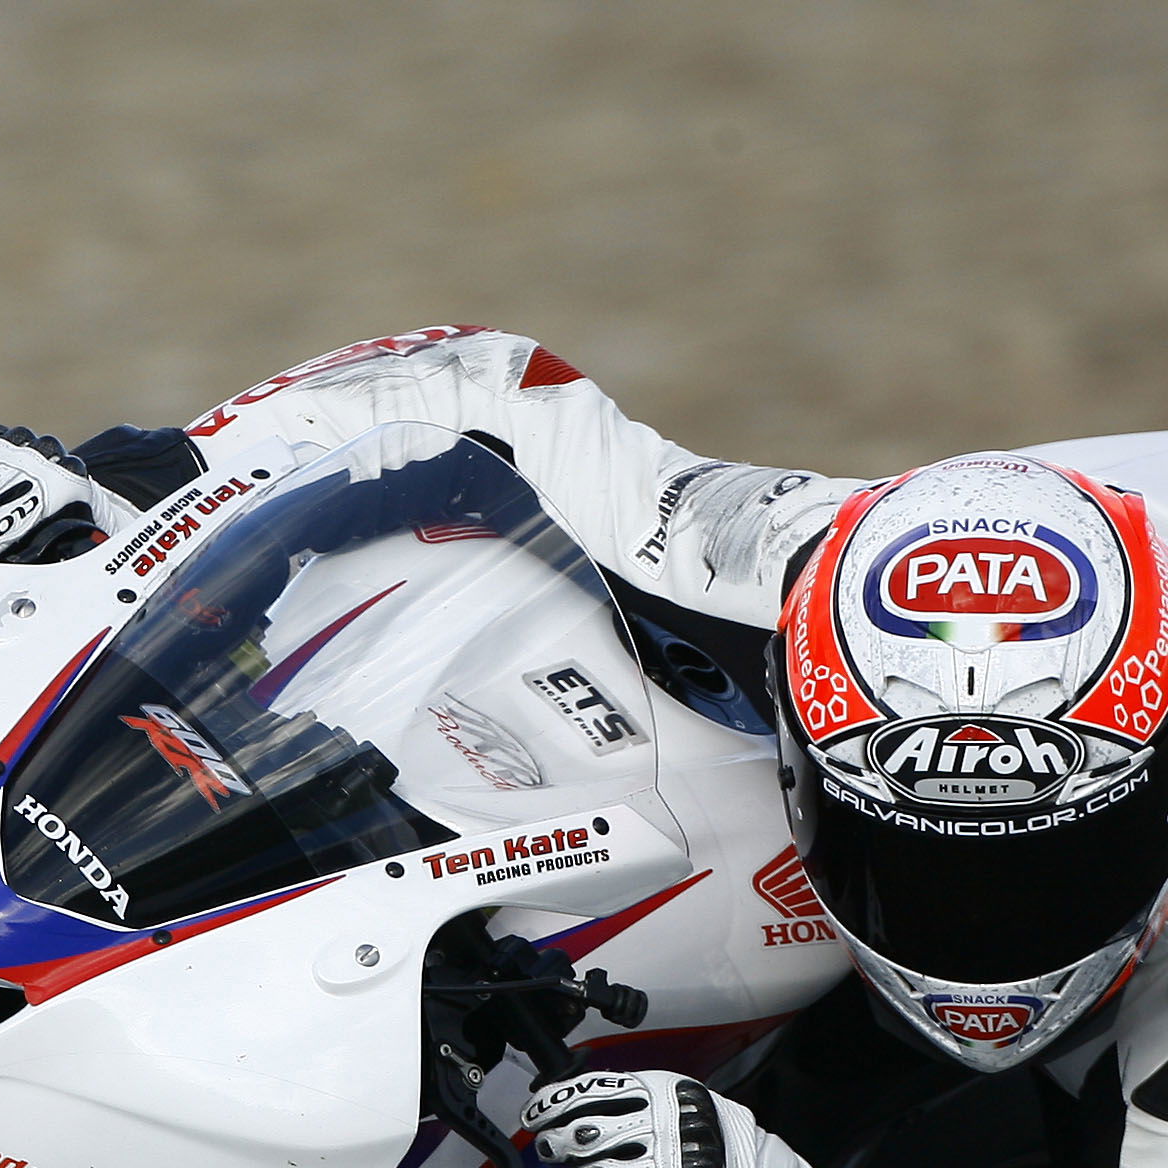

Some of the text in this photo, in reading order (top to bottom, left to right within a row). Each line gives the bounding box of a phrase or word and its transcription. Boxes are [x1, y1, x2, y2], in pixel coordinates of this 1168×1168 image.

[105, 488, 203, 575] RACING PRODUCTS
[132, 477, 255, 577] Ten Kate
[932, 518, 1032, 536] SNACK
[906, 552, 1048, 603] PATA
[533, 679, 603, 747] Racing Fuels
[546, 667, 637, 743] ETS
[883, 725, 1071, 775] Airoh
[822, 768, 1150, 836] GALVANICOLOR.COM
[938, 783, 1010, 794] HELMET
[13, 794, 130, 920] HONDA
[423, 828, 589, 880] Ten Kate
[476, 849, 610, 886] RACING PRODUCTS
[944, 1010, 1019, 1033] PATA
[952, 994, 1007, 1004] SNACK
